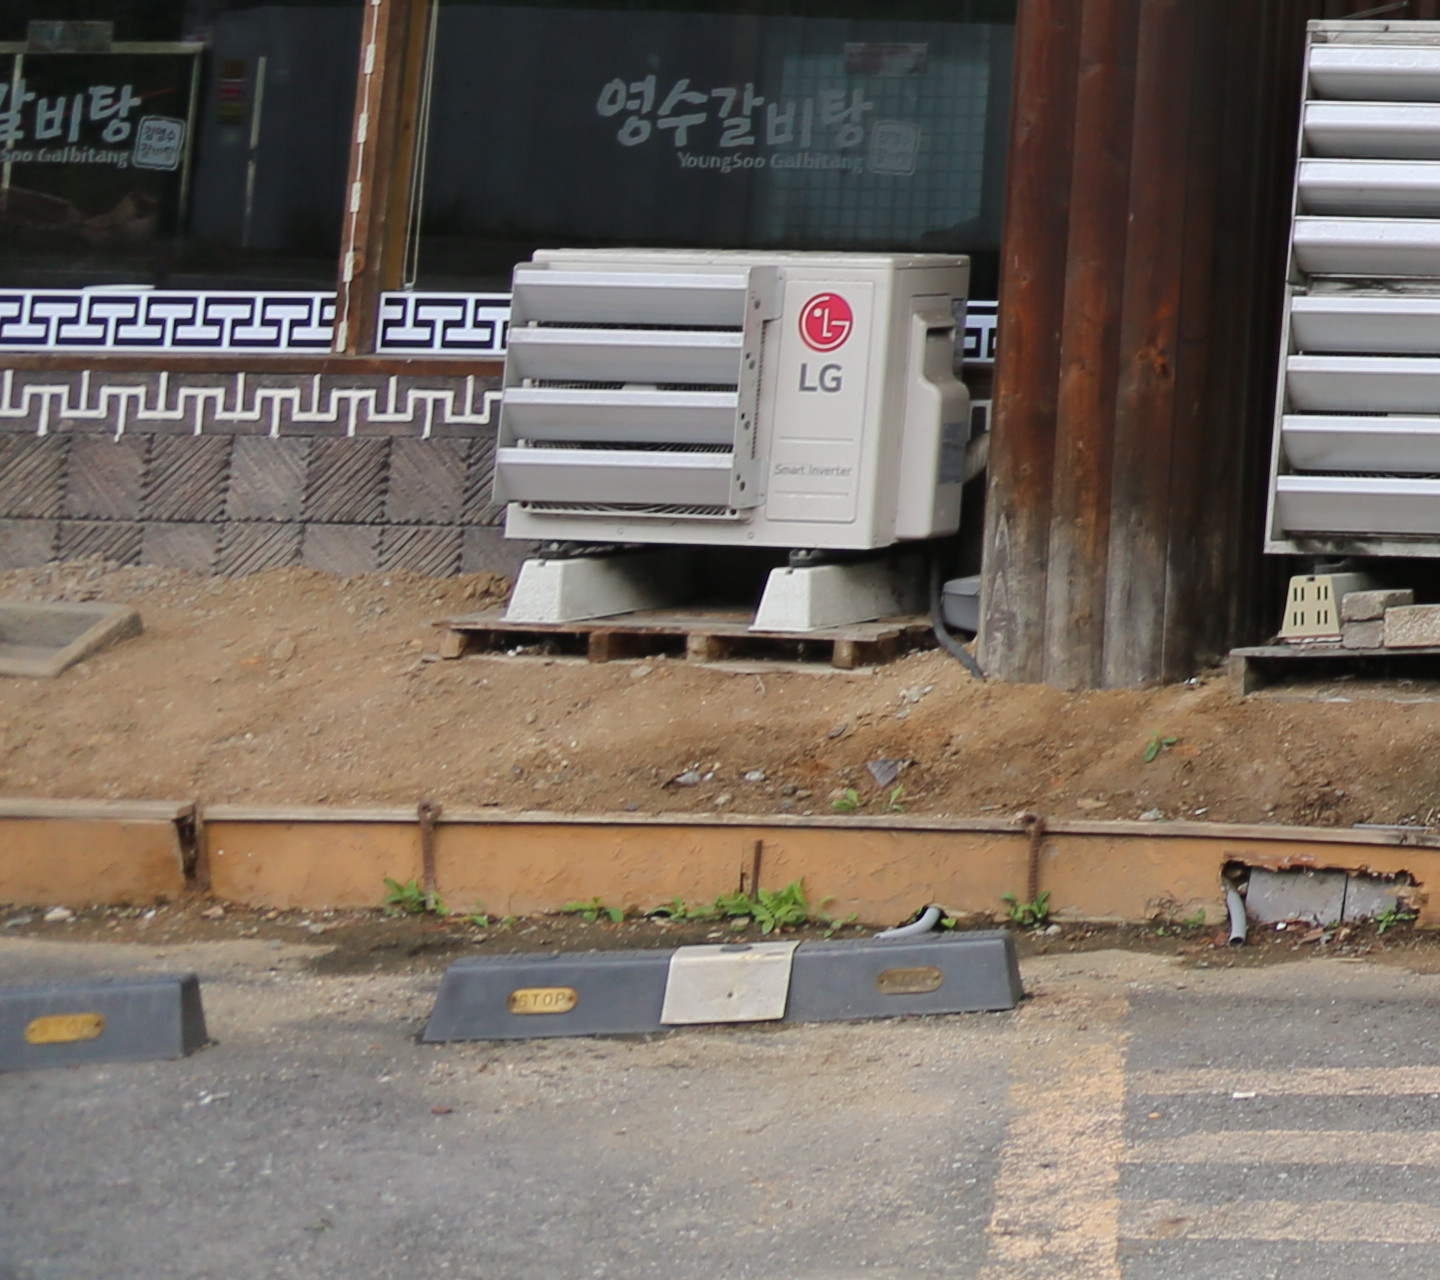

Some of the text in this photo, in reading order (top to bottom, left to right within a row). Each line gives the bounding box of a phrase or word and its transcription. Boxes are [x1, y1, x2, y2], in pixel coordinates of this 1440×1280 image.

[596, 74, 873, 148] 영수갈비탕
[37, 146, 129, 169] Galbitang
[677, 151, 766, 173] YoungSoo
[798, 362, 843, 393] LG
[774, 463, 806, 476] Smart
[519, 991, 566, 1008] STOP
